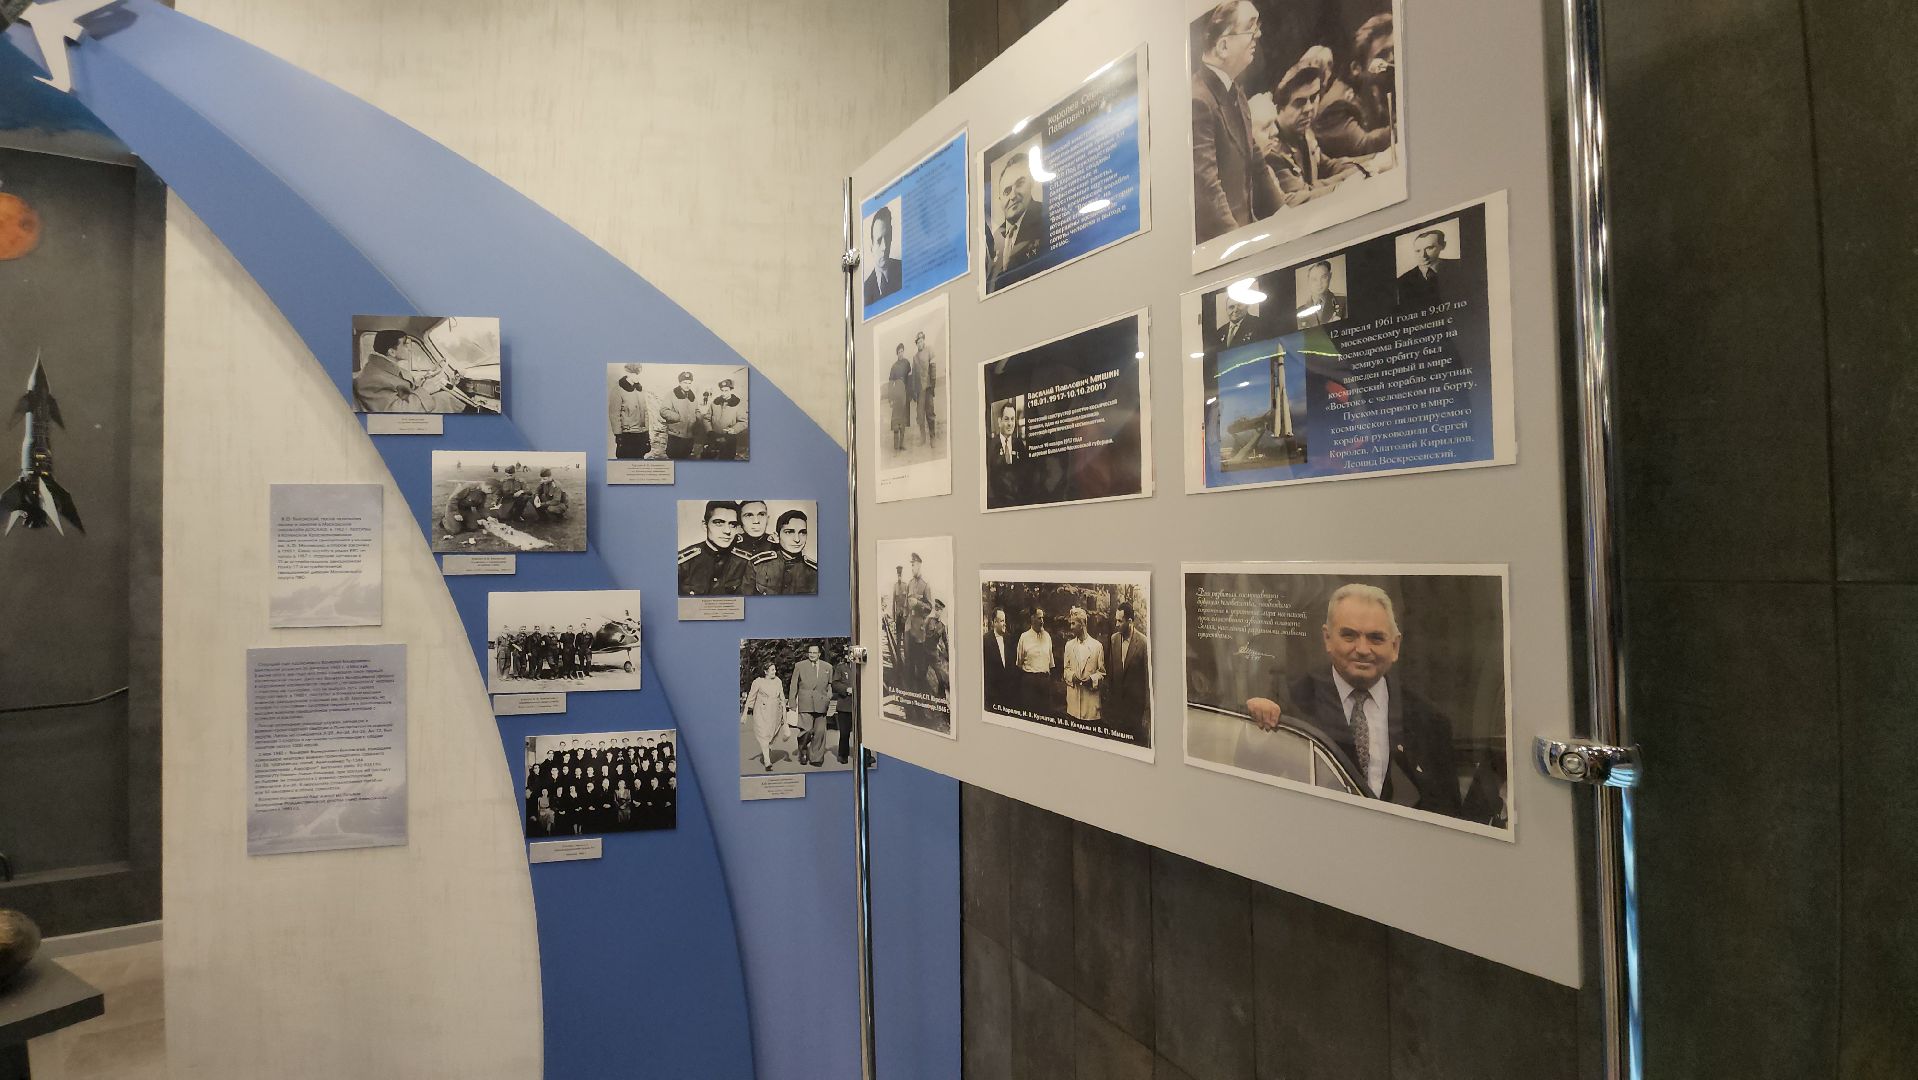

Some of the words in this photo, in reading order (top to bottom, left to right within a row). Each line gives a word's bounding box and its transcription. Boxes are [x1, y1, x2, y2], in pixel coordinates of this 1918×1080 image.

[1048, 108, 1085, 136] Павлович
[1330, 329, 1338, 339] 12
[1341, 323, 1371, 337] апреля
[1374, 317, 1394, 329] 1961
[1397, 312, 1419, 323] года
[1421, 309, 1427, 317] в
[1429, 302, 1451, 316] 9:07
[1454, 300, 1468, 309] по
[1341, 329, 1400, 349] московскому
[1403, 318, 1445, 336] времени
[1447, 316, 1454, 325] с
[1337, 343, 1392, 361] космодрома
[1394, 331, 1443, 349] Байконур
[1445, 329, 1458, 338] на
[1352, 358, 1384, 371] земную
[1386, 349, 1420, 364] орбиту
[1422, 345, 1443, 356] был
[1027, 386, 1055, 400] Василий
[1055, 378, 1089, 393] Павлович
[1090, 369, 1120, 384] Мишин
[1328, 382, 1385, 400] космический
[1388, 374, 1427, 391] корабль
[1429, 366, 1473, 383] спутник
[1343, 371, 1379, 385] выведен
[1381, 361, 1416, 377] первый
[1419, 362, 1425, 370] в
[1427, 356, 1453, 370] мире
[1325, 396, 1366, 412] «Восток»
[1368, 395, 1374, 404] с
[1376, 387, 1427, 402] человеком
[1429, 385, 1441, 394] на
[1443, 379, 1478, 395] борту.
[1343, 409, 1379, 423] Пуском
[1380, 402, 1418, 418] первого
[1421, 401, 1427, 409] в
[1428, 396, 1454, 410] мире
[1330, 418, 1392, 435] космического
[1394, 407, 1472, 427] пилотируемого
[1333, 433, 1369, 448] корабля
[1371, 426, 1428, 445] руководили
[1431, 421, 1468, 436] Сергей
[1371, 440, 1418, 454] Анатолий
[1344, 456, 1378, 469] Леонид
